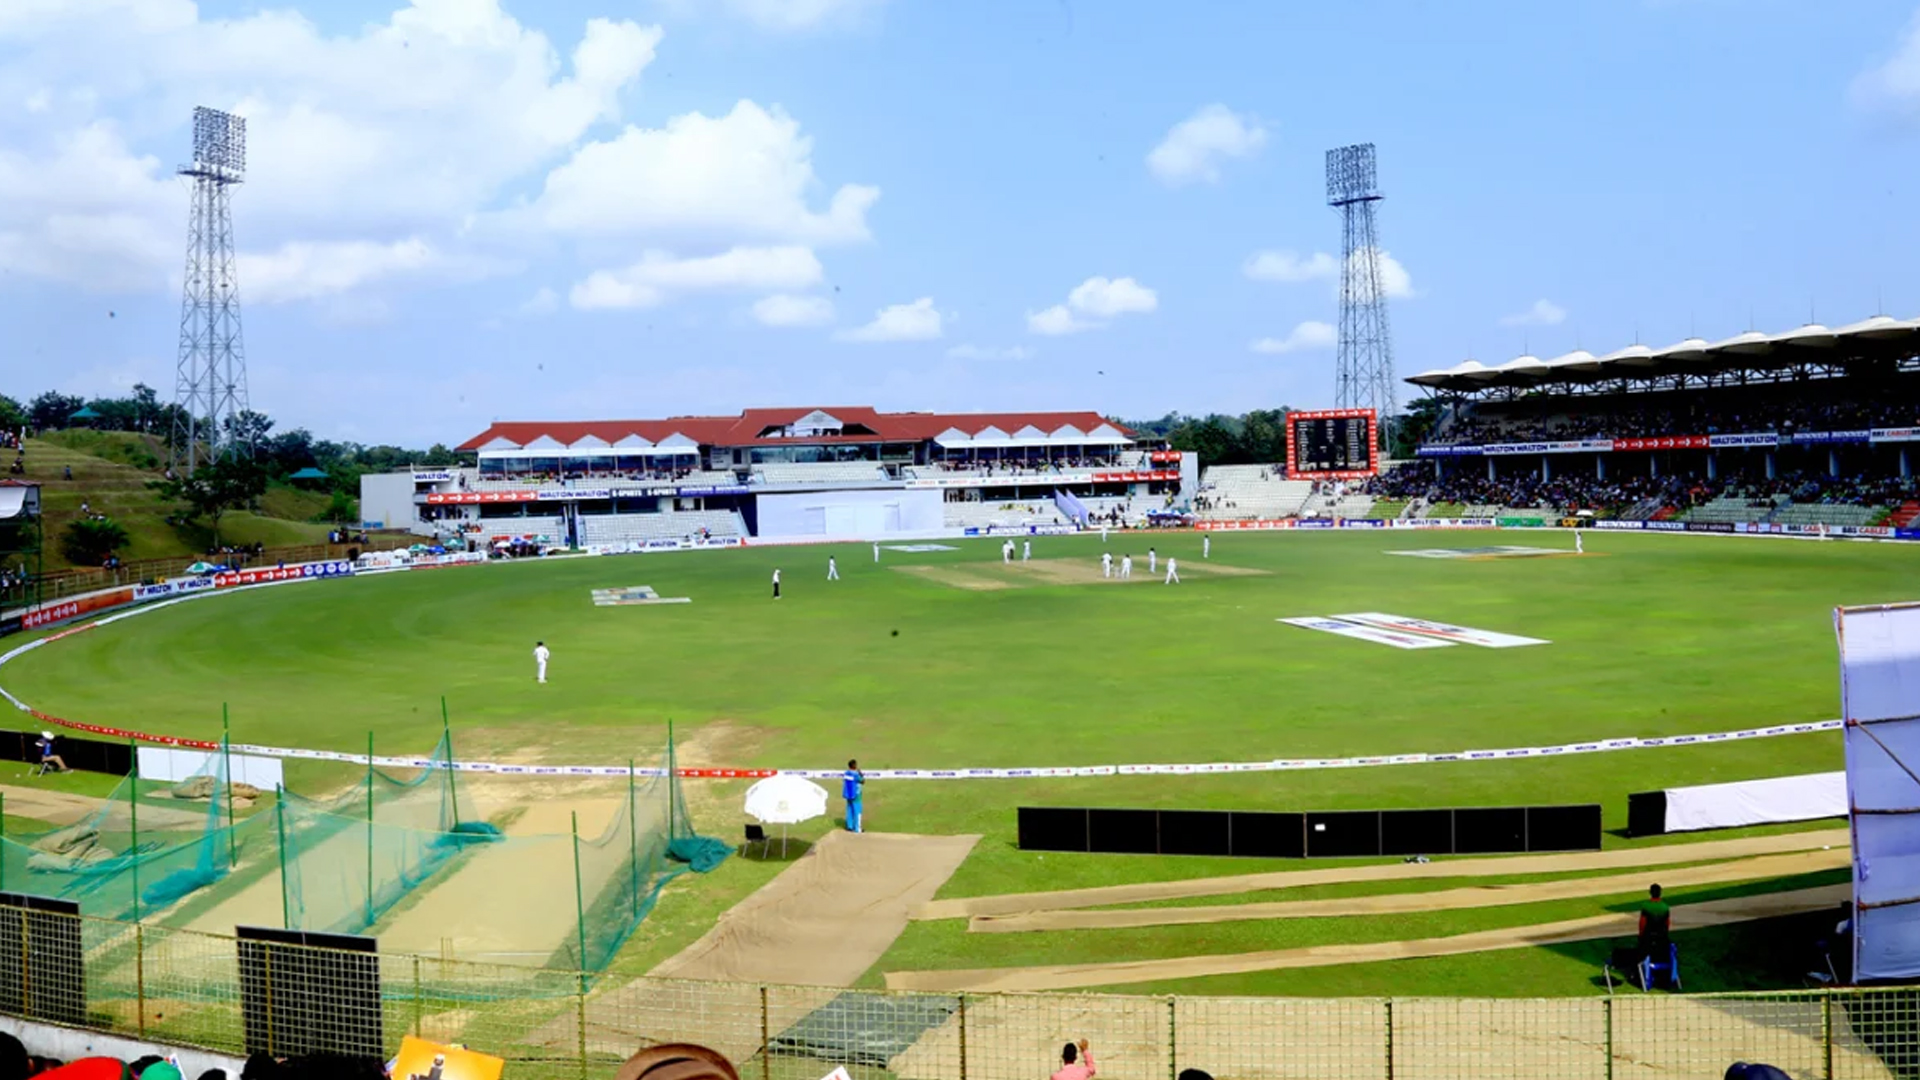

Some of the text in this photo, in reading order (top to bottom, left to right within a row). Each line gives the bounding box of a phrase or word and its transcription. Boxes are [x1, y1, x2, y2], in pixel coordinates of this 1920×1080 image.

[1711, 437, 1742, 445] WALTON
[1743, 435, 1778, 444] WALTON
[539, 490, 573, 498] WALTON
[574, 489, 609, 497] WALTON
[708, 538, 737, 546] WALTON
[188, 578, 212, 588] WALTON
[147, 584, 172, 595] WALTON
